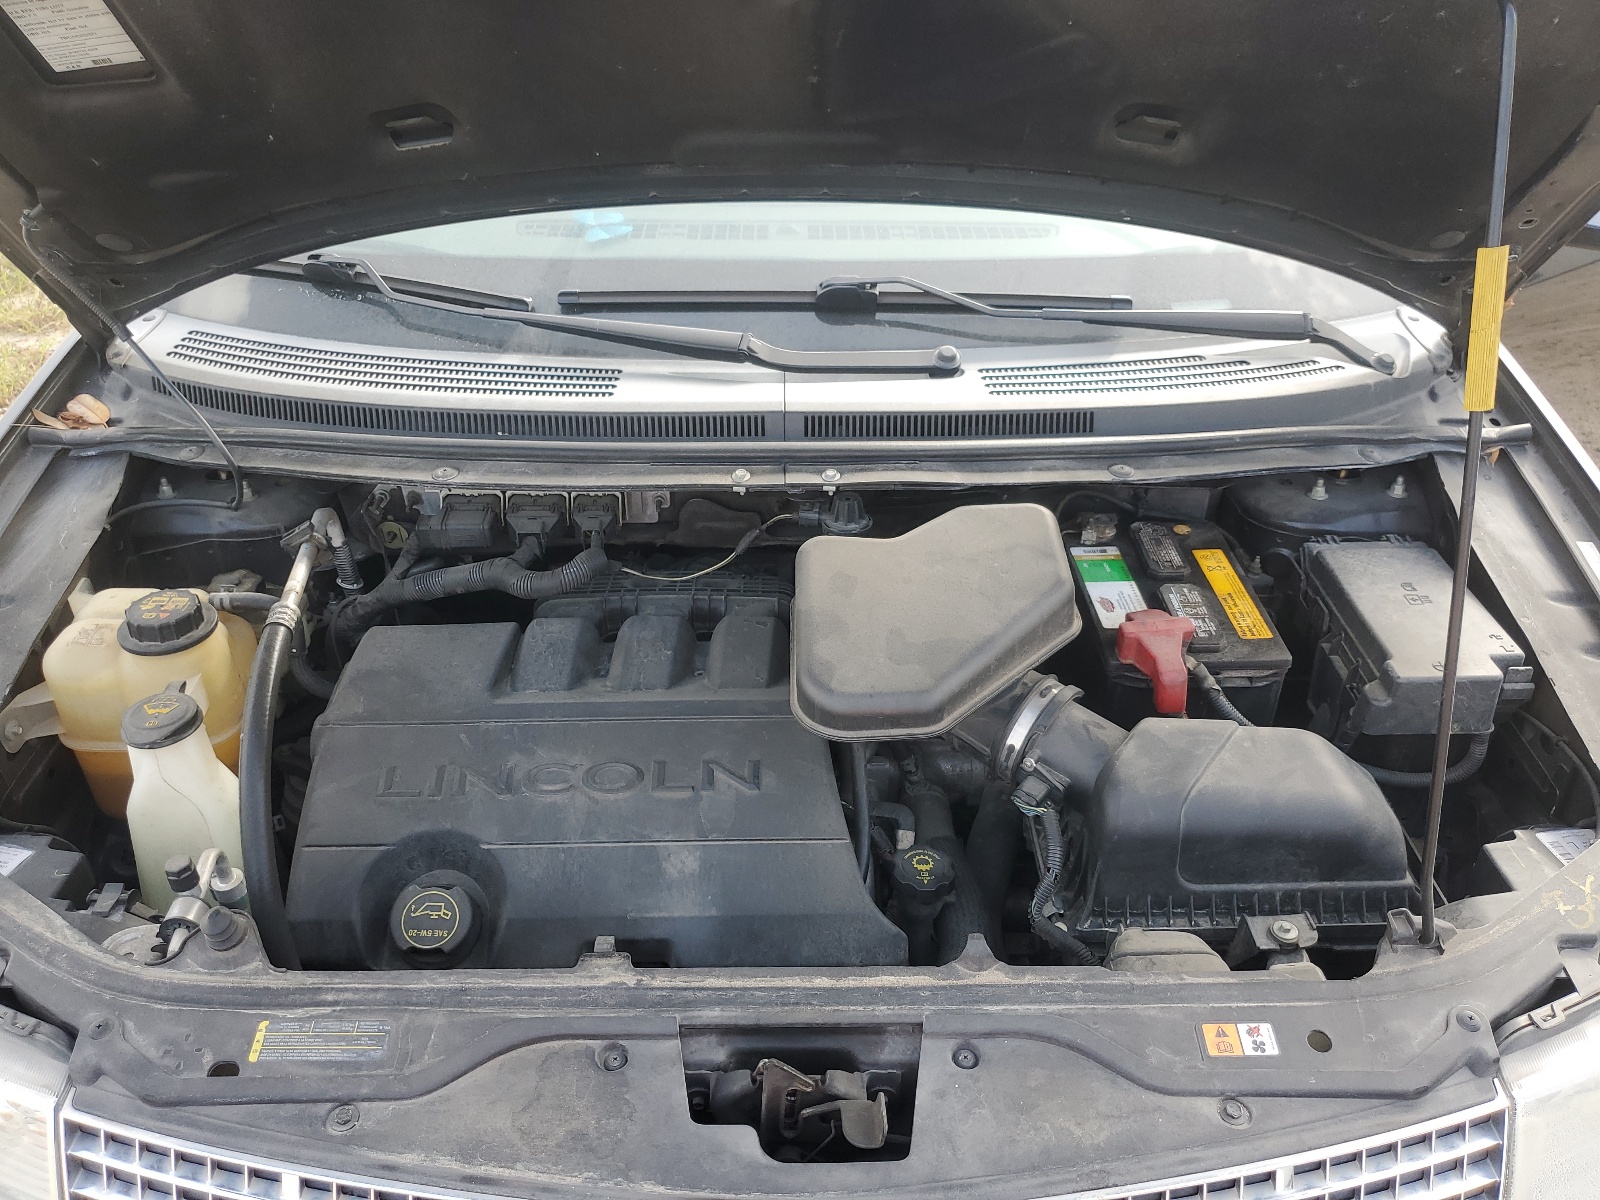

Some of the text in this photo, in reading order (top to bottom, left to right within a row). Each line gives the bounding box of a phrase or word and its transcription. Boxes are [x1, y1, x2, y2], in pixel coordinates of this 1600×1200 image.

[376, 759, 761, 799] LINCOLN
[408, 929, 449, 938] SAE 5W-20
